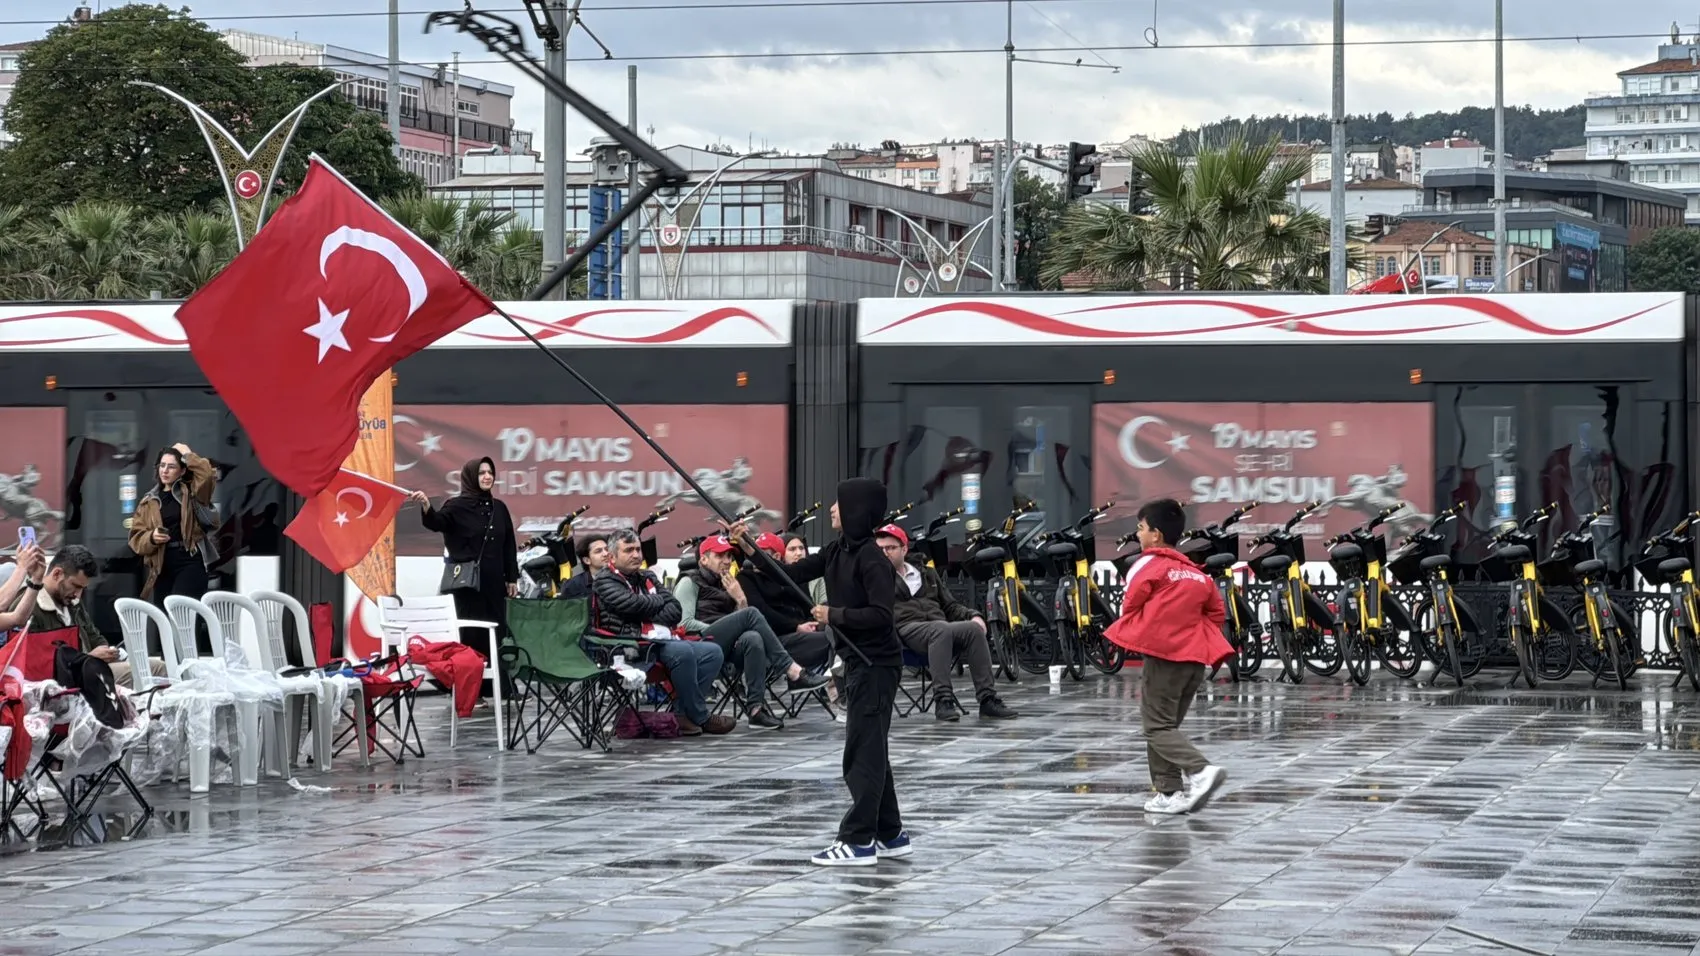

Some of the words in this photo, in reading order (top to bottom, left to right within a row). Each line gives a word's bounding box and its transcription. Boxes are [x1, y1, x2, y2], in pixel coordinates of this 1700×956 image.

[496, 426, 536, 462] 19
[536, 436, 633, 463] MAYIS
[1241, 429, 1318, 449] MAYIS
[543, 470, 685, 496] SAMSUN
[1191, 475, 1337, 504] SAMSUN
